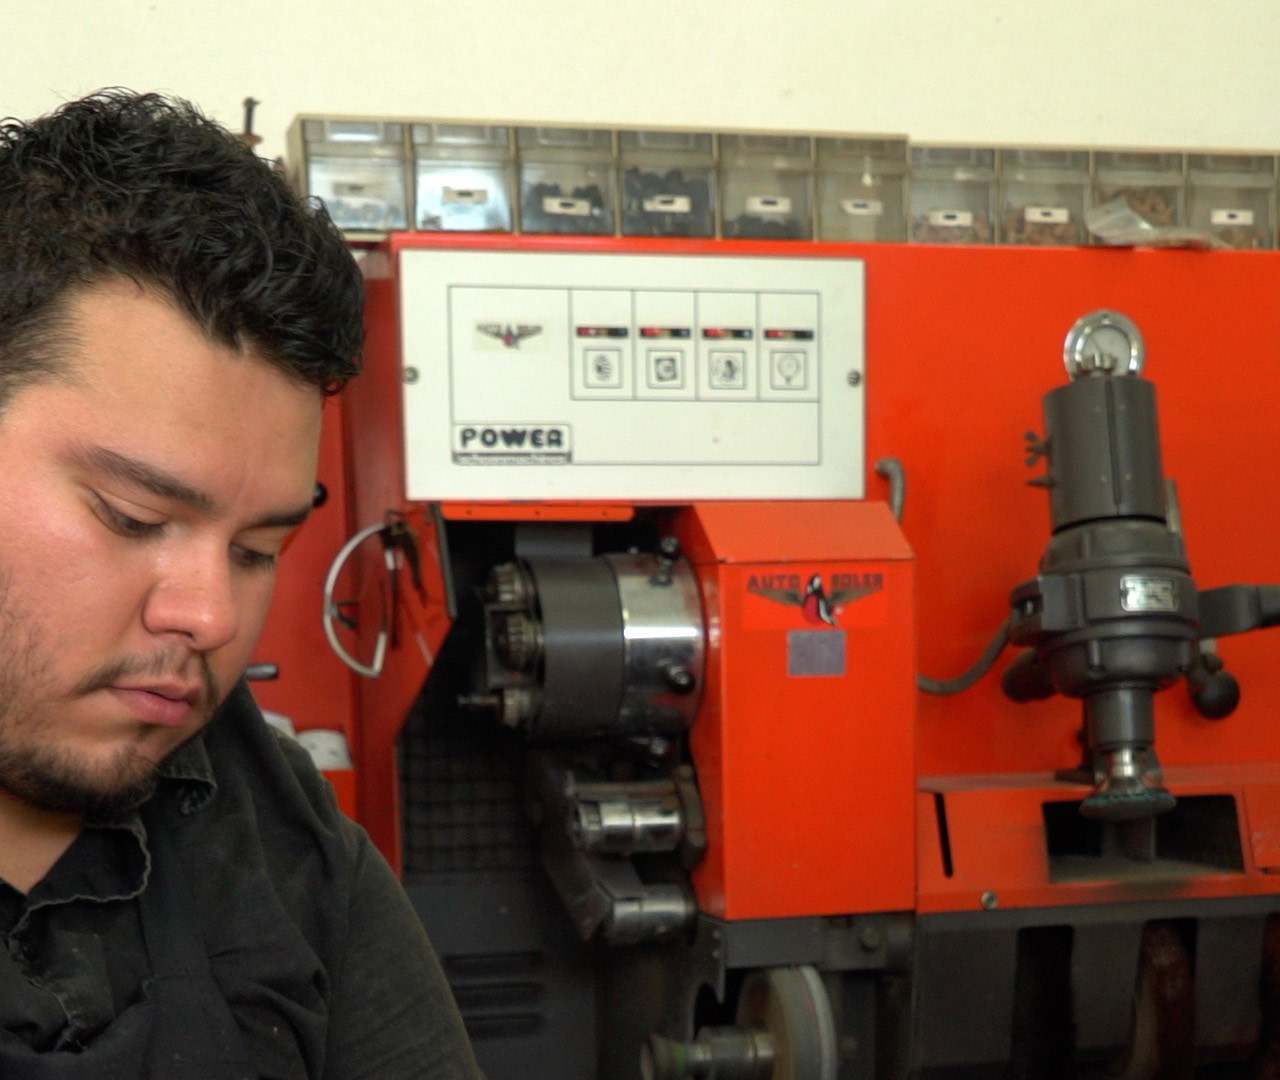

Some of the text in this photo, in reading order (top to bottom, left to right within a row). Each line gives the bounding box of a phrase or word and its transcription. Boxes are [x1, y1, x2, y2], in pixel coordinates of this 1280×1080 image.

[460, 427, 563, 448] POWER
[747, 573, 883, 591] AUTO SOLER
